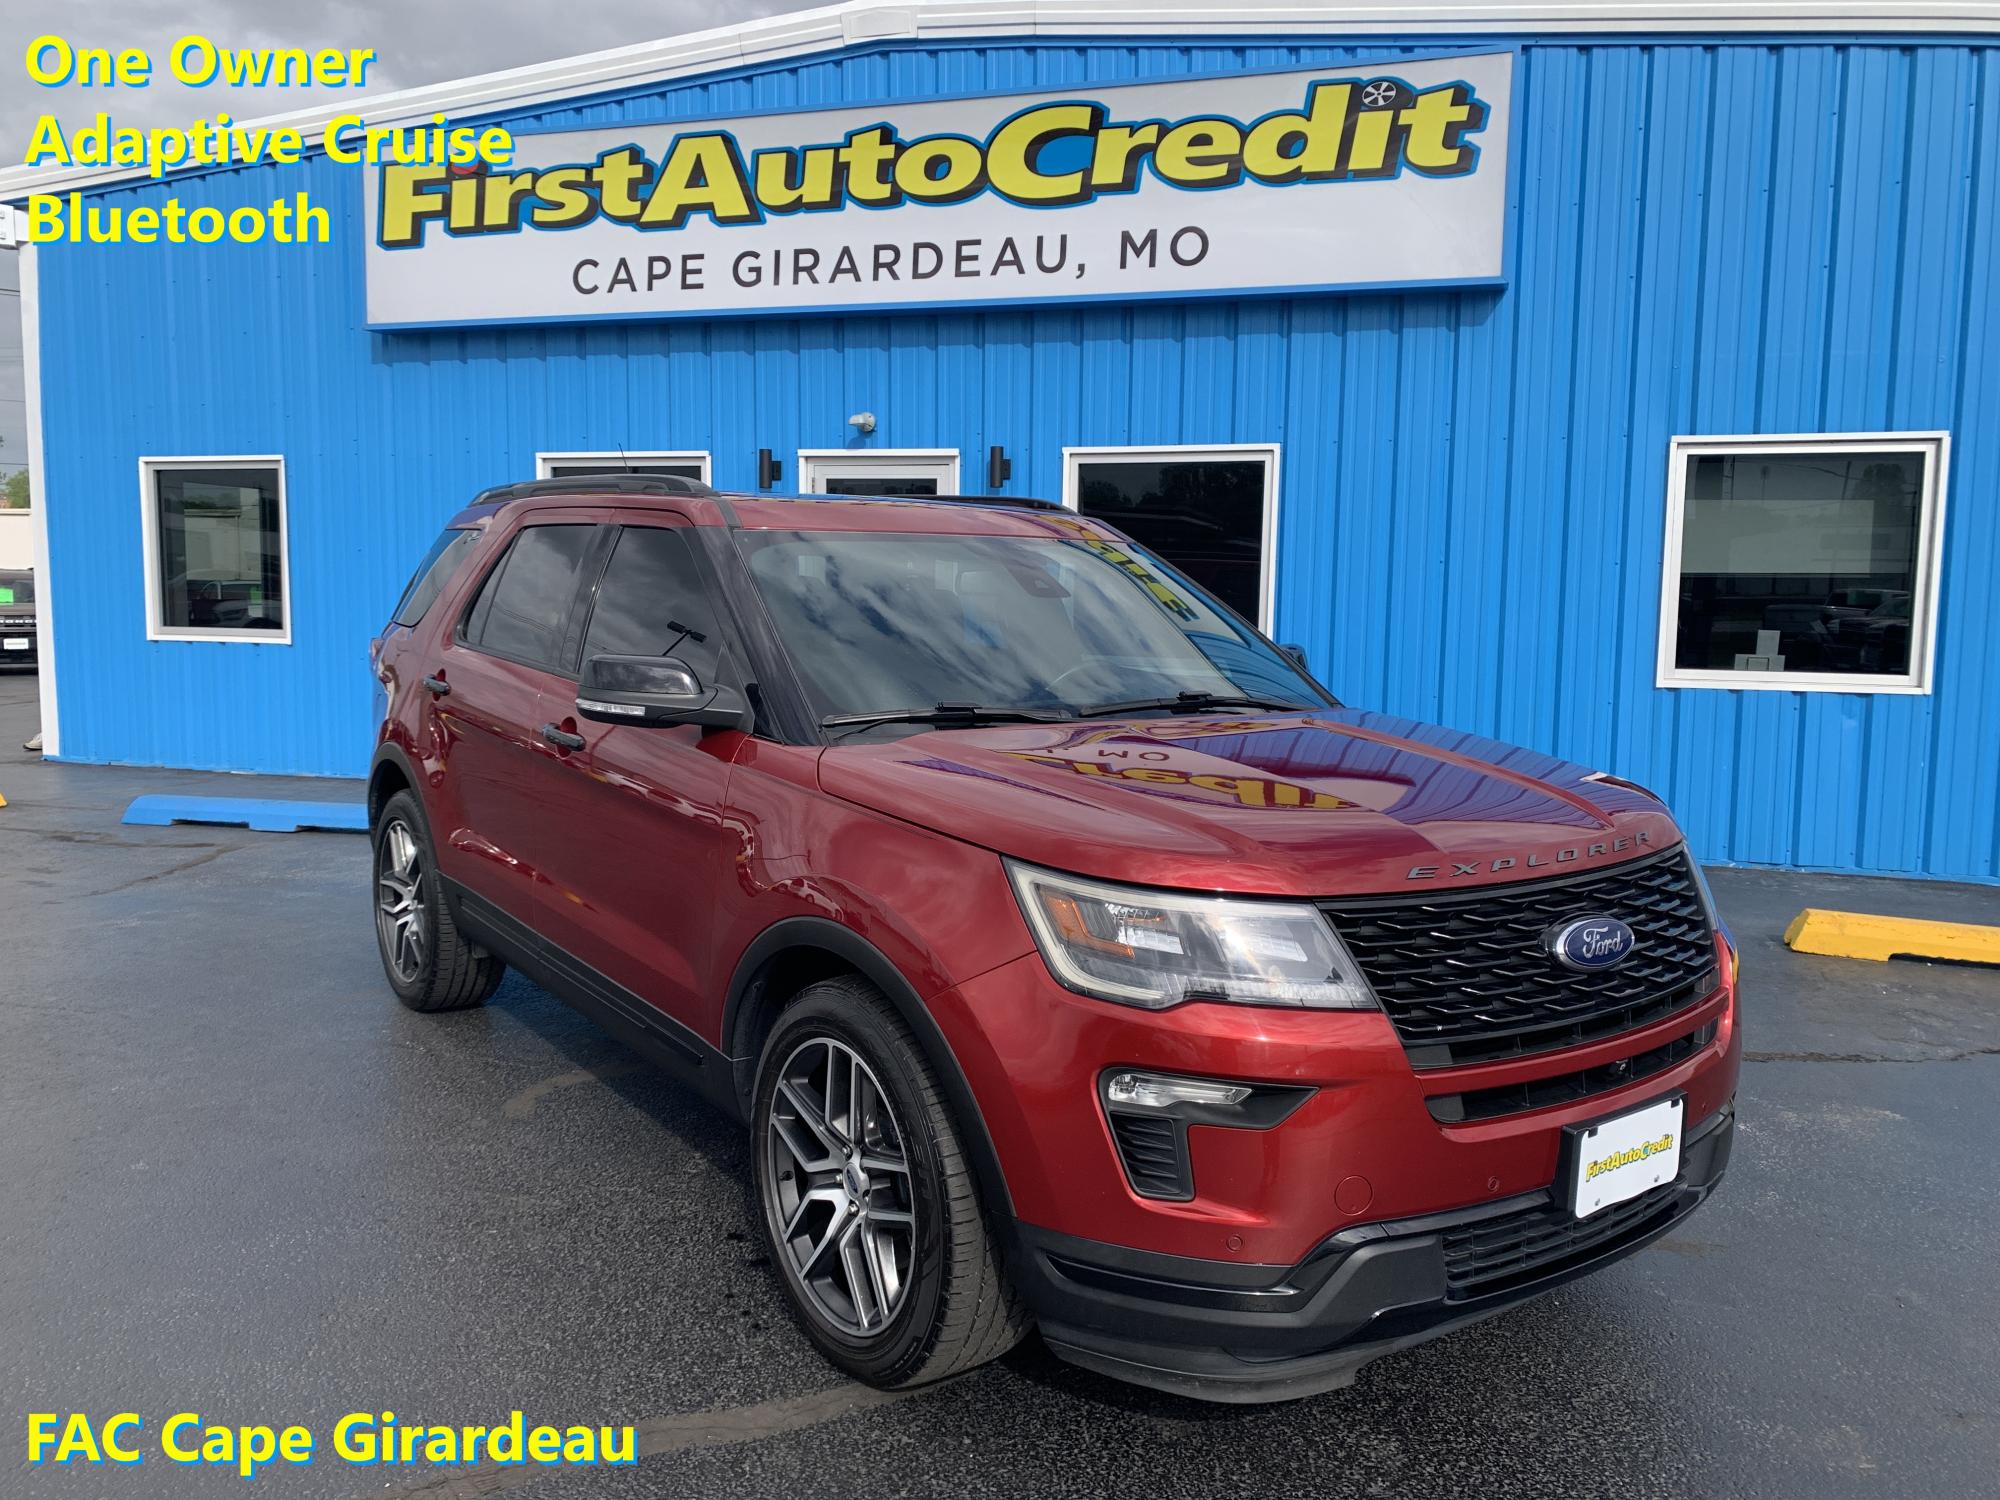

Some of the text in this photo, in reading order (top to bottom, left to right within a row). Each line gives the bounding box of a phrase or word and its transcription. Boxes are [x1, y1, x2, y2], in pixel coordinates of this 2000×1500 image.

[378, 76, 1491, 250] FirstAutoCredit
[571, 224, 1211, 295] CAPE GIRARDEAU, MO
[1406, 831, 1650, 880] EXPLORER
[1582, 926, 1624, 959] Ford
[1585, 1133, 1674, 1182] FirstAutoCredit
